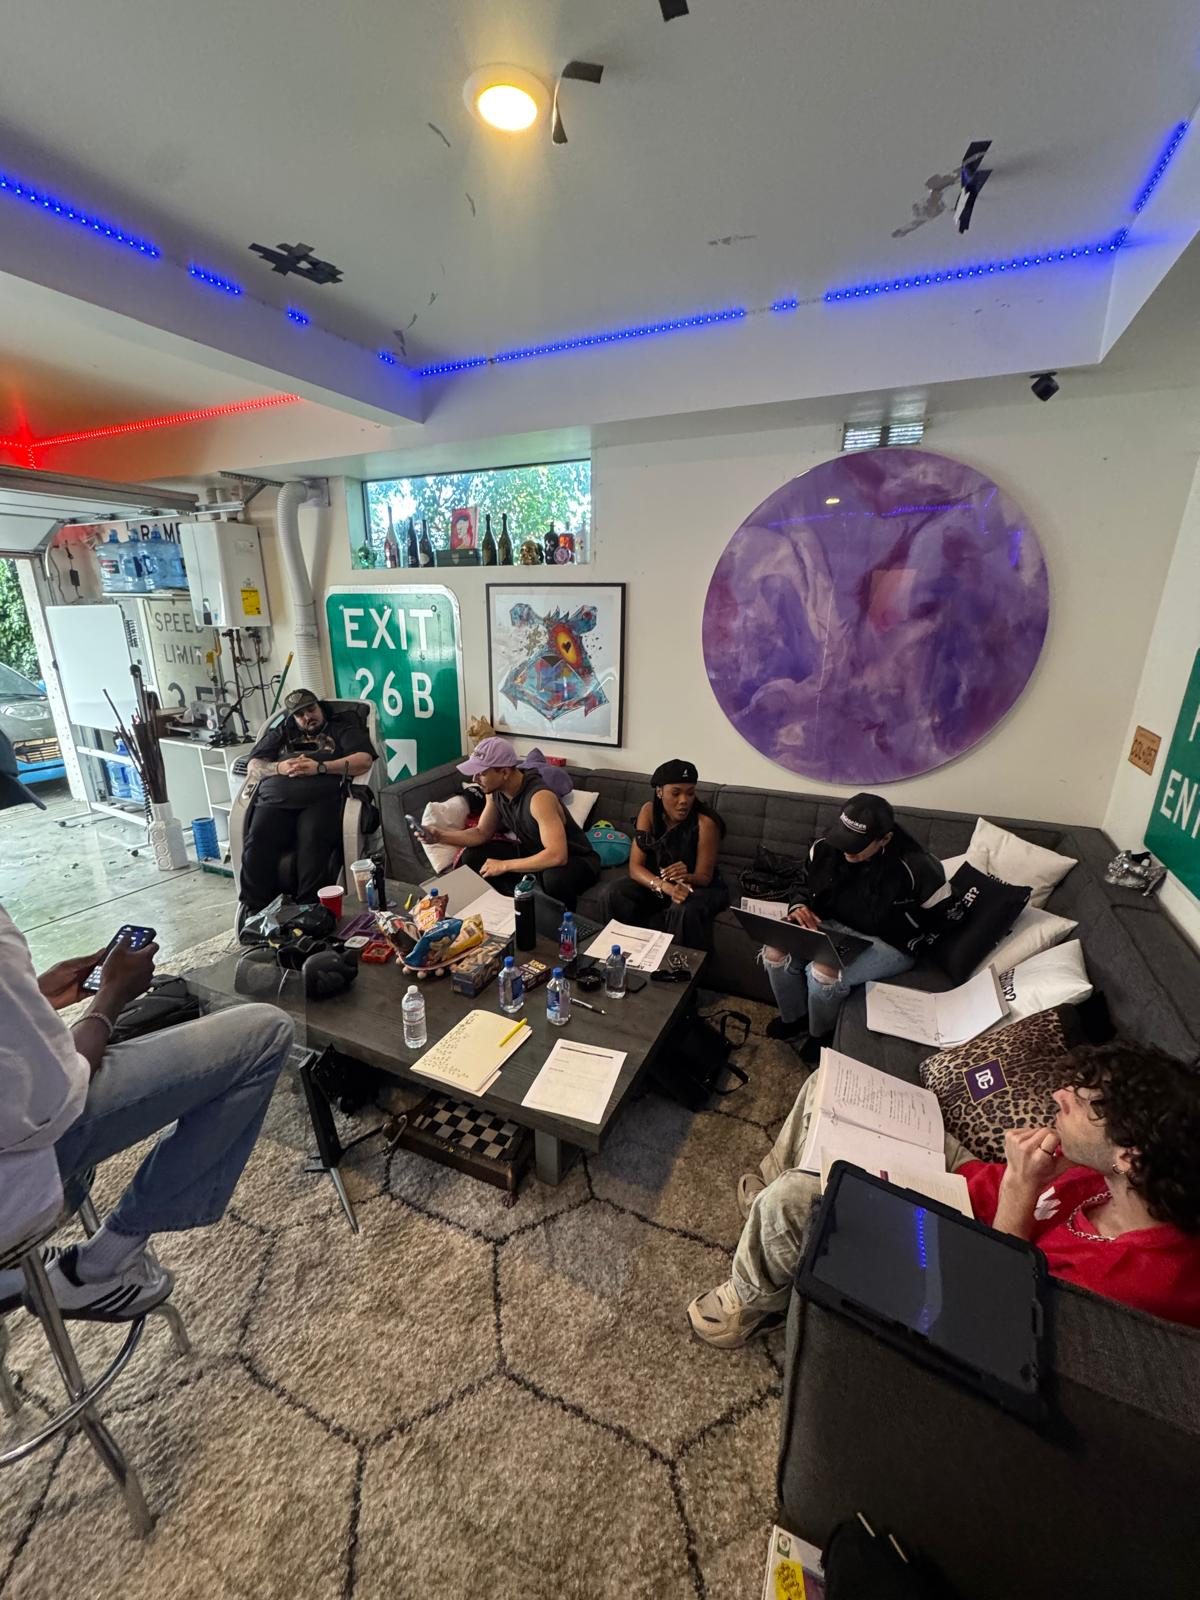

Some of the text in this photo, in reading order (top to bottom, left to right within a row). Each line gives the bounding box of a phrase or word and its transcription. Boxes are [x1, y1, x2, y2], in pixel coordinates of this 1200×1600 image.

[140, 522, 182, 544] RMP
[155, 612, 204, 633] SPEE
[343, 608, 434, 651] EXIT
[163, 643, 202, 665] LIMIT
